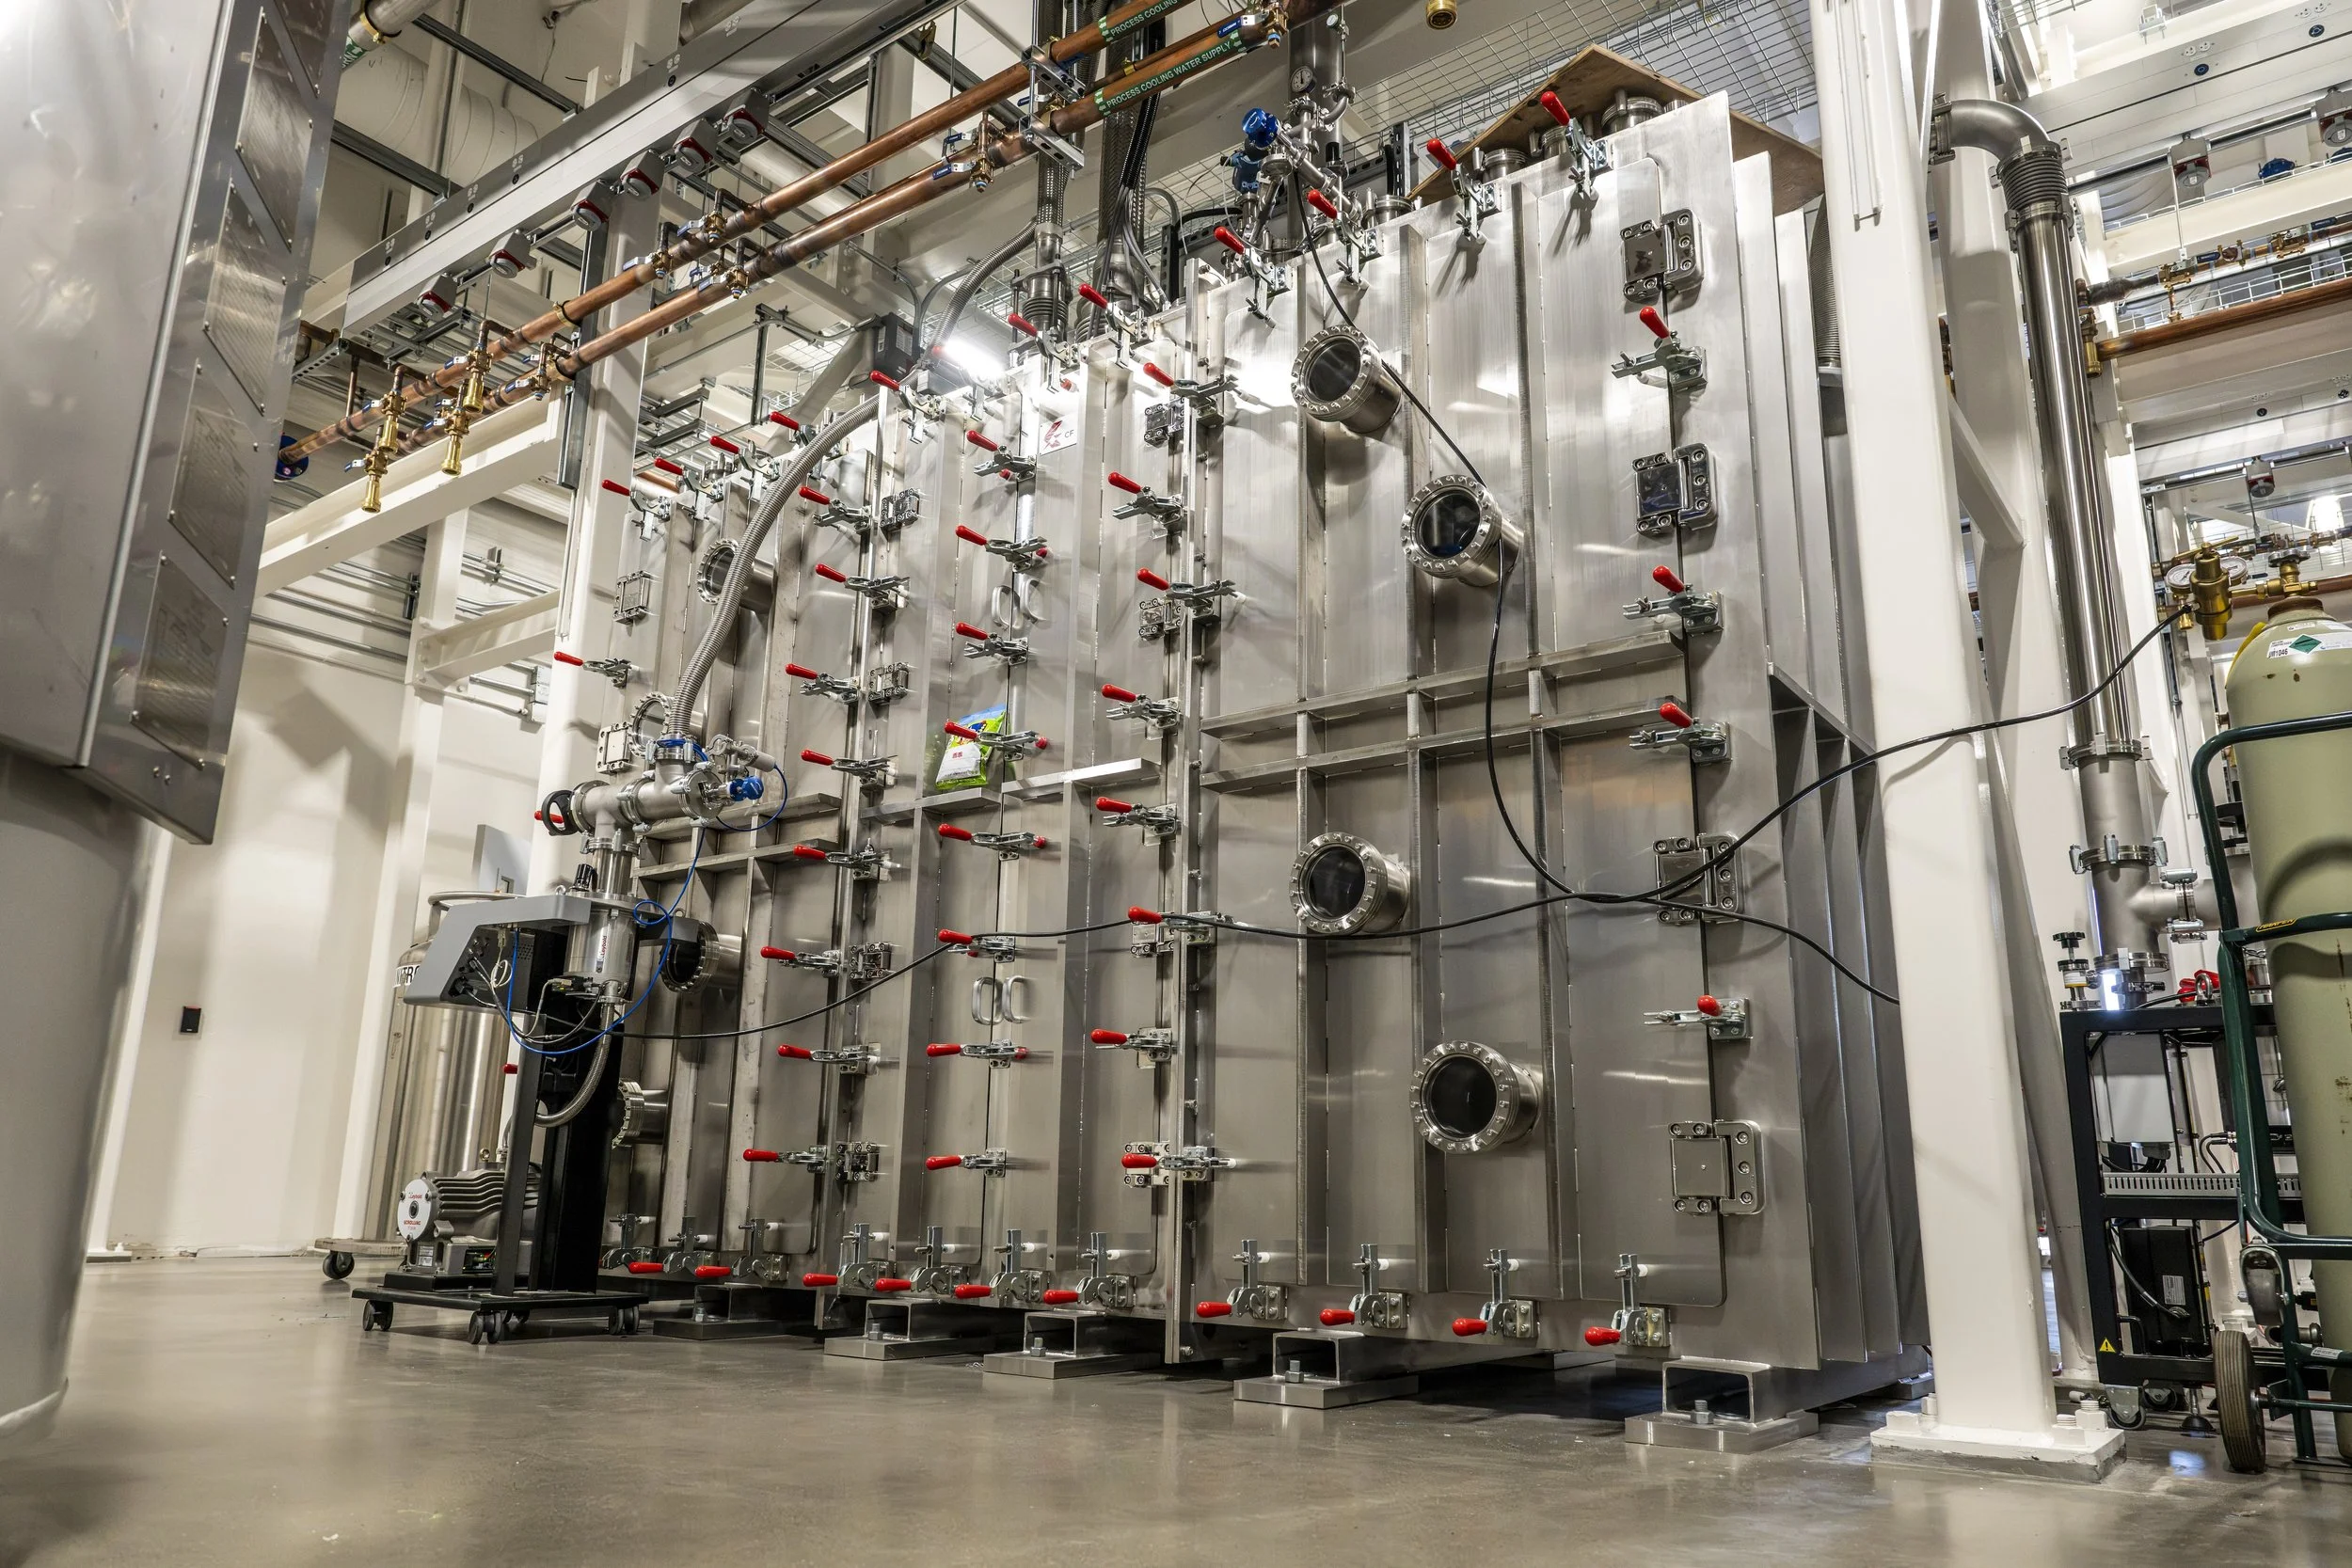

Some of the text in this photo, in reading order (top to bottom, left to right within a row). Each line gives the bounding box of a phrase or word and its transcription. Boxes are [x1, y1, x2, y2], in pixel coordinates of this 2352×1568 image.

[1110, 0, 1178, 37] PROCESS COOLING
[1106, 40, 1232, 108] PROCESS COOLING WATER SUPPLY
